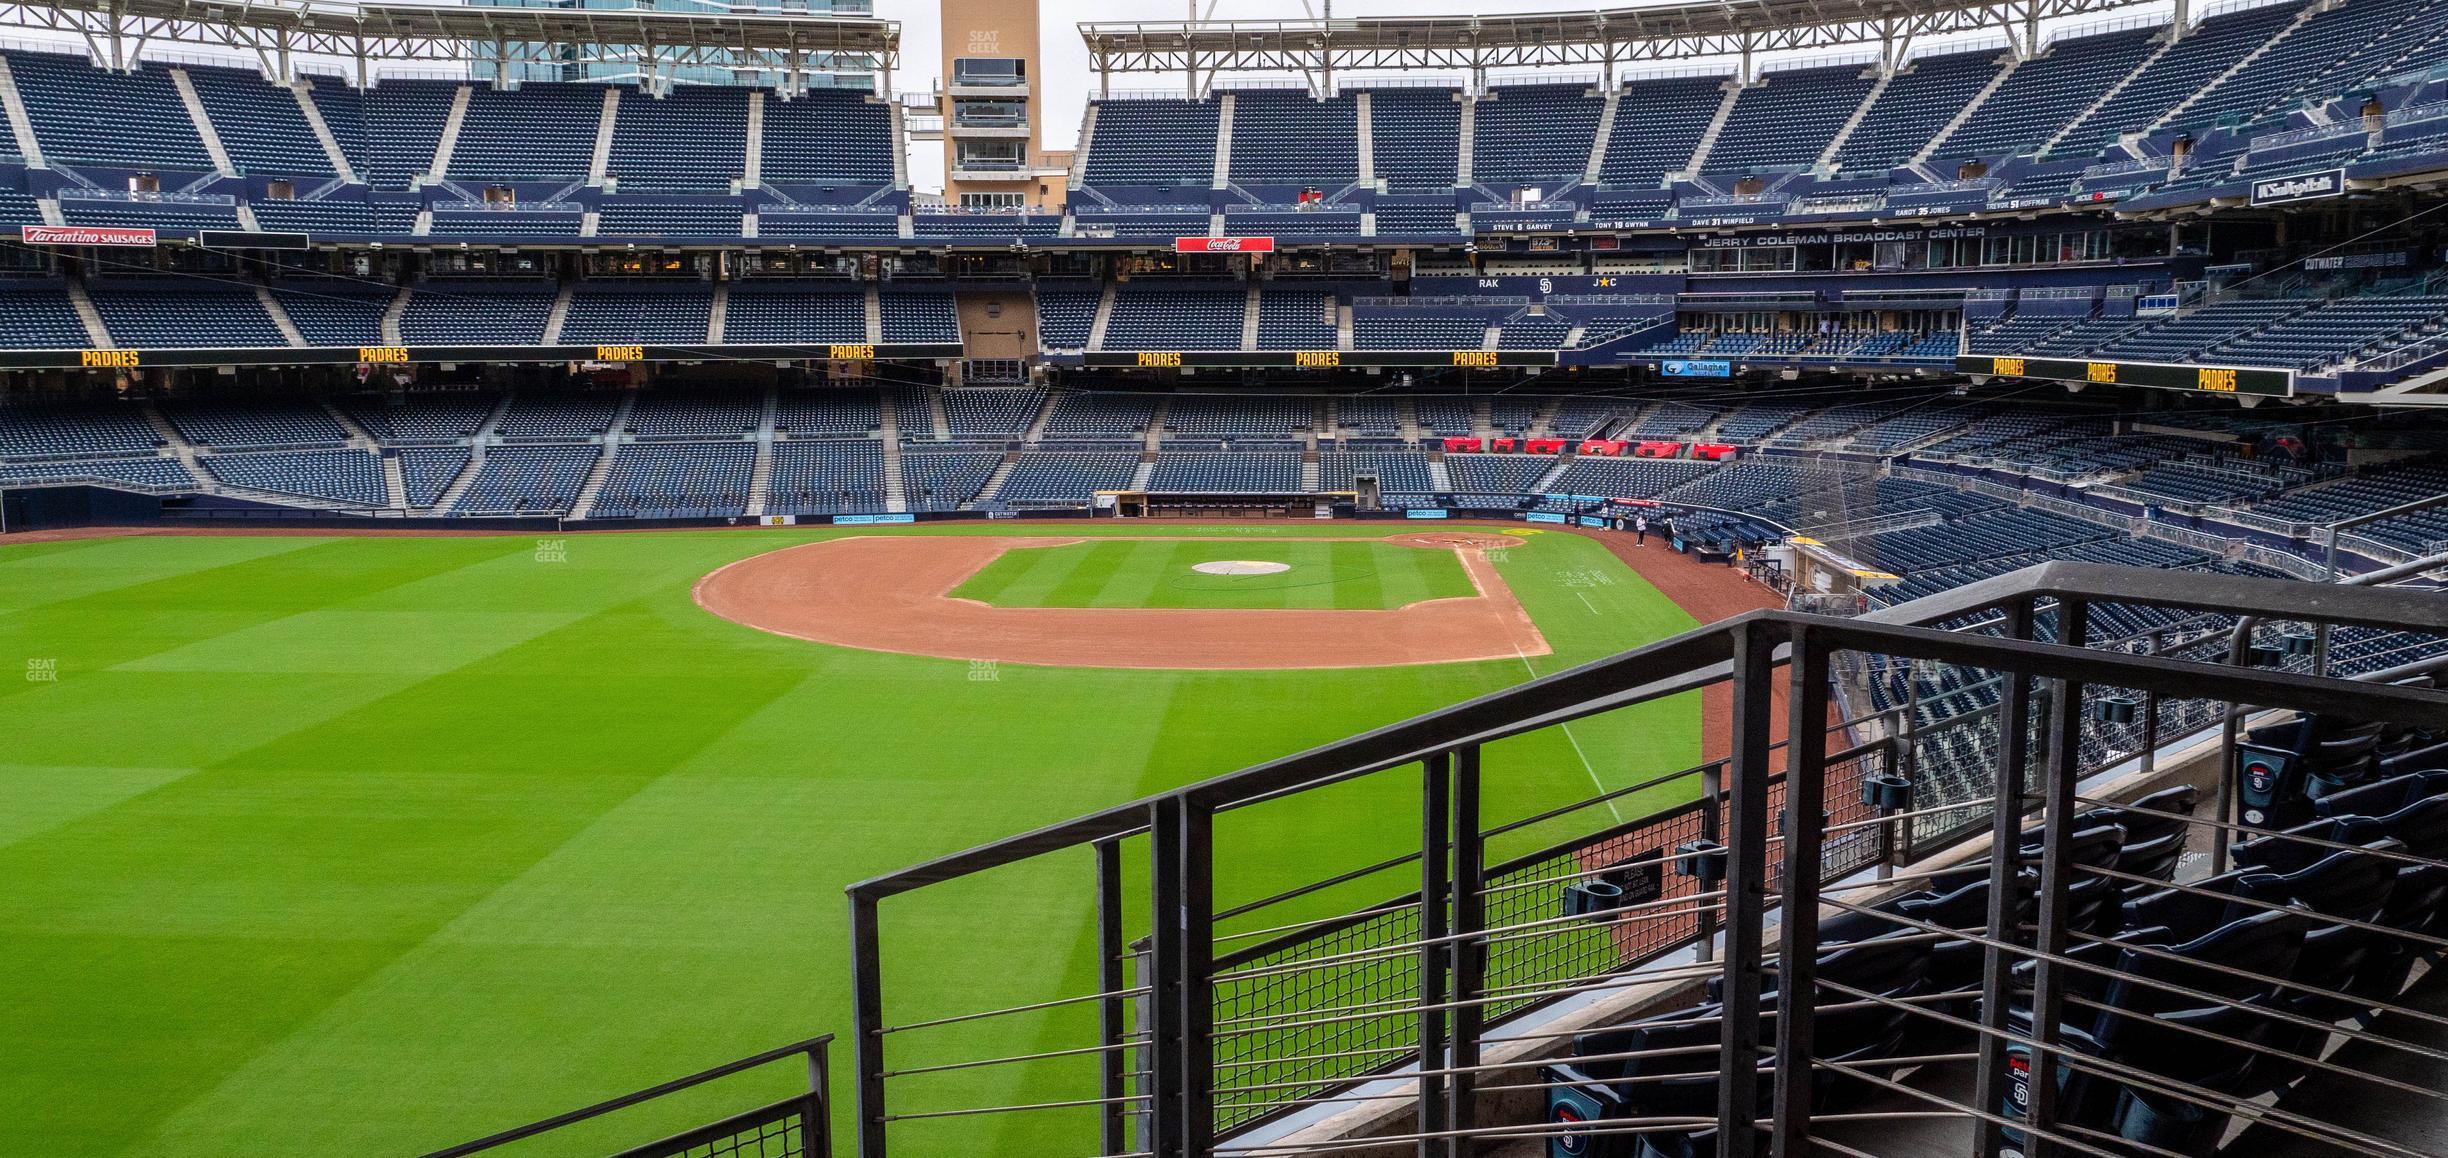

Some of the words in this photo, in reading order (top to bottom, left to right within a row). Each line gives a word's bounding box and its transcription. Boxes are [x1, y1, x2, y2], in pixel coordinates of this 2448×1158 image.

[1986, 201, 2009, 210] TREVOR
[2010, 200, 2020, 209] 51
[2020, 198, 2050, 207] HOFFMAN
[1894, 208, 1916, 217] RANDY
[1917, 207, 1928, 216] 35
[1929, 206, 1950, 215] JONES
[1711, 218, 1720, 226] 31
[26, 228, 99, 244] Tarantino
[100, 233, 154, 244] SAUSAGES
[1704, 236, 1751, 248] JERRY
[1756, 234, 1828, 246] COLEMAN
[1833, 230, 1923, 243] BROADCAST
[1928, 227, 1985, 239] CENTER
[2304, 256, 2344, 270] CUTWATER
[1478, 279, 1499, 288] RAK
[82, 350, 139, 366] PADRES
[359, 347, 408, 362] PADRES
[597, 346, 643, 360] PADRES
[830, 344, 874, 359] PADRES
[1138, 352, 1181, 366] PADRES
[1296, 352, 1339, 366] PADRES
[1453, 352, 1497, 366] PADRES
[1687, 362, 1727, 371] Gallagher
[1993, 358, 2024, 376] PADRES
[2087, 362, 2116, 383] PADRES
[2198, 368, 2236, 392] PADRES
[2014, 1068, 2029, 1078] par
[2014, 1082, 2029, 1106] SD
